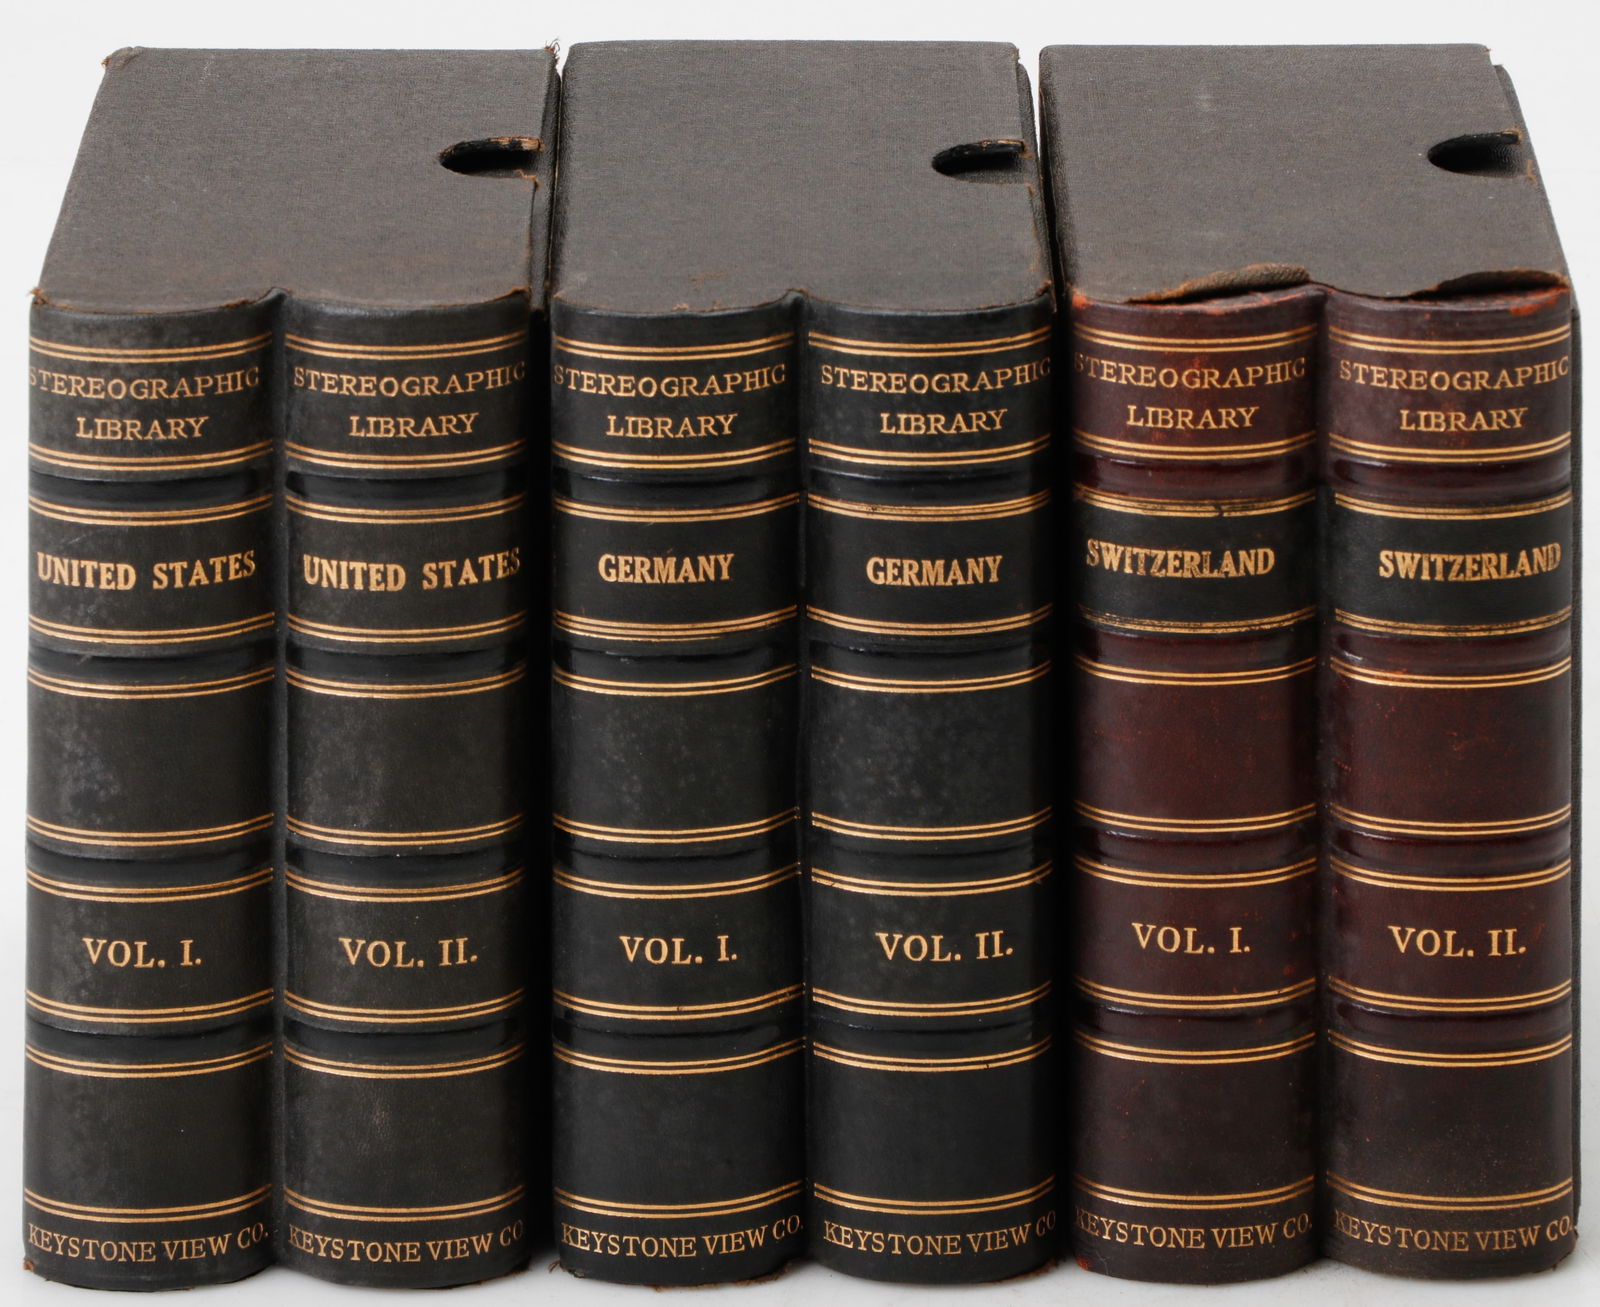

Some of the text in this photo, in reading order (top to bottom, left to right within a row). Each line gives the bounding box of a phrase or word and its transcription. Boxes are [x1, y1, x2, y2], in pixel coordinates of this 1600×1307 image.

[29, 365, 260, 400] STEREOGRAPHIC
[294, 361, 525, 397] STEREOGRAPHIC
[553, 364, 786, 398] STEREOGRAPHIC
[821, 357, 1051, 394] STEREOGRAPHIC
[1074, 352, 1306, 390] STEREOGRAPHIC
[1339, 356, 1569, 391] STEREOGRAPHIC
[76, 416, 210, 440] LIBRARY
[349, 412, 480, 438] LIBRARY
[607, 413, 738, 439] LIBRARY
[881, 409, 1008, 435] LIBRARY
[1126, 404, 1260, 430] LIBRARY
[1399, 407, 1529, 432] LIBRARY
[37, 550, 256, 591] UNITED STATES
[303, 547, 521, 592] UNITED STATES
[598, 553, 735, 584] GERMANY
[866, 555, 1003, 587] GERMANY
[1086, 539, 1276, 579] SWITZERLAND
[1379, 542, 1562, 582] SWITZERLAND
[82, 937, 202, 968] VOL. I.
[338, 937, 479, 968] VOL. II.
[619, 935, 738, 965] VOL. I.
[875, 930, 1014, 962] VOL. II.
[1131, 922, 1251, 955] VOL. I.
[1387, 925, 1527, 958] VOL. II.
[28, 1222, 269, 1263] KEYSTONE VIEW CO.
[288, 1223, 422, 1263] KEYSTONE
[426, 1232, 495, 1261] VIEW
[561, 1222, 697, 1258] KEYSTONE
[701, 1224, 769, 1256] VIEW
[824, 1220, 963, 1256] KEYSTONE
[966, 1224, 1032, 1253] VIEW
[1075, 1205, 1313, 1249] KEYSTONE VIEW CO.
[1334, 1209, 1575, 1252] KEYSTONE VIEW CO.
